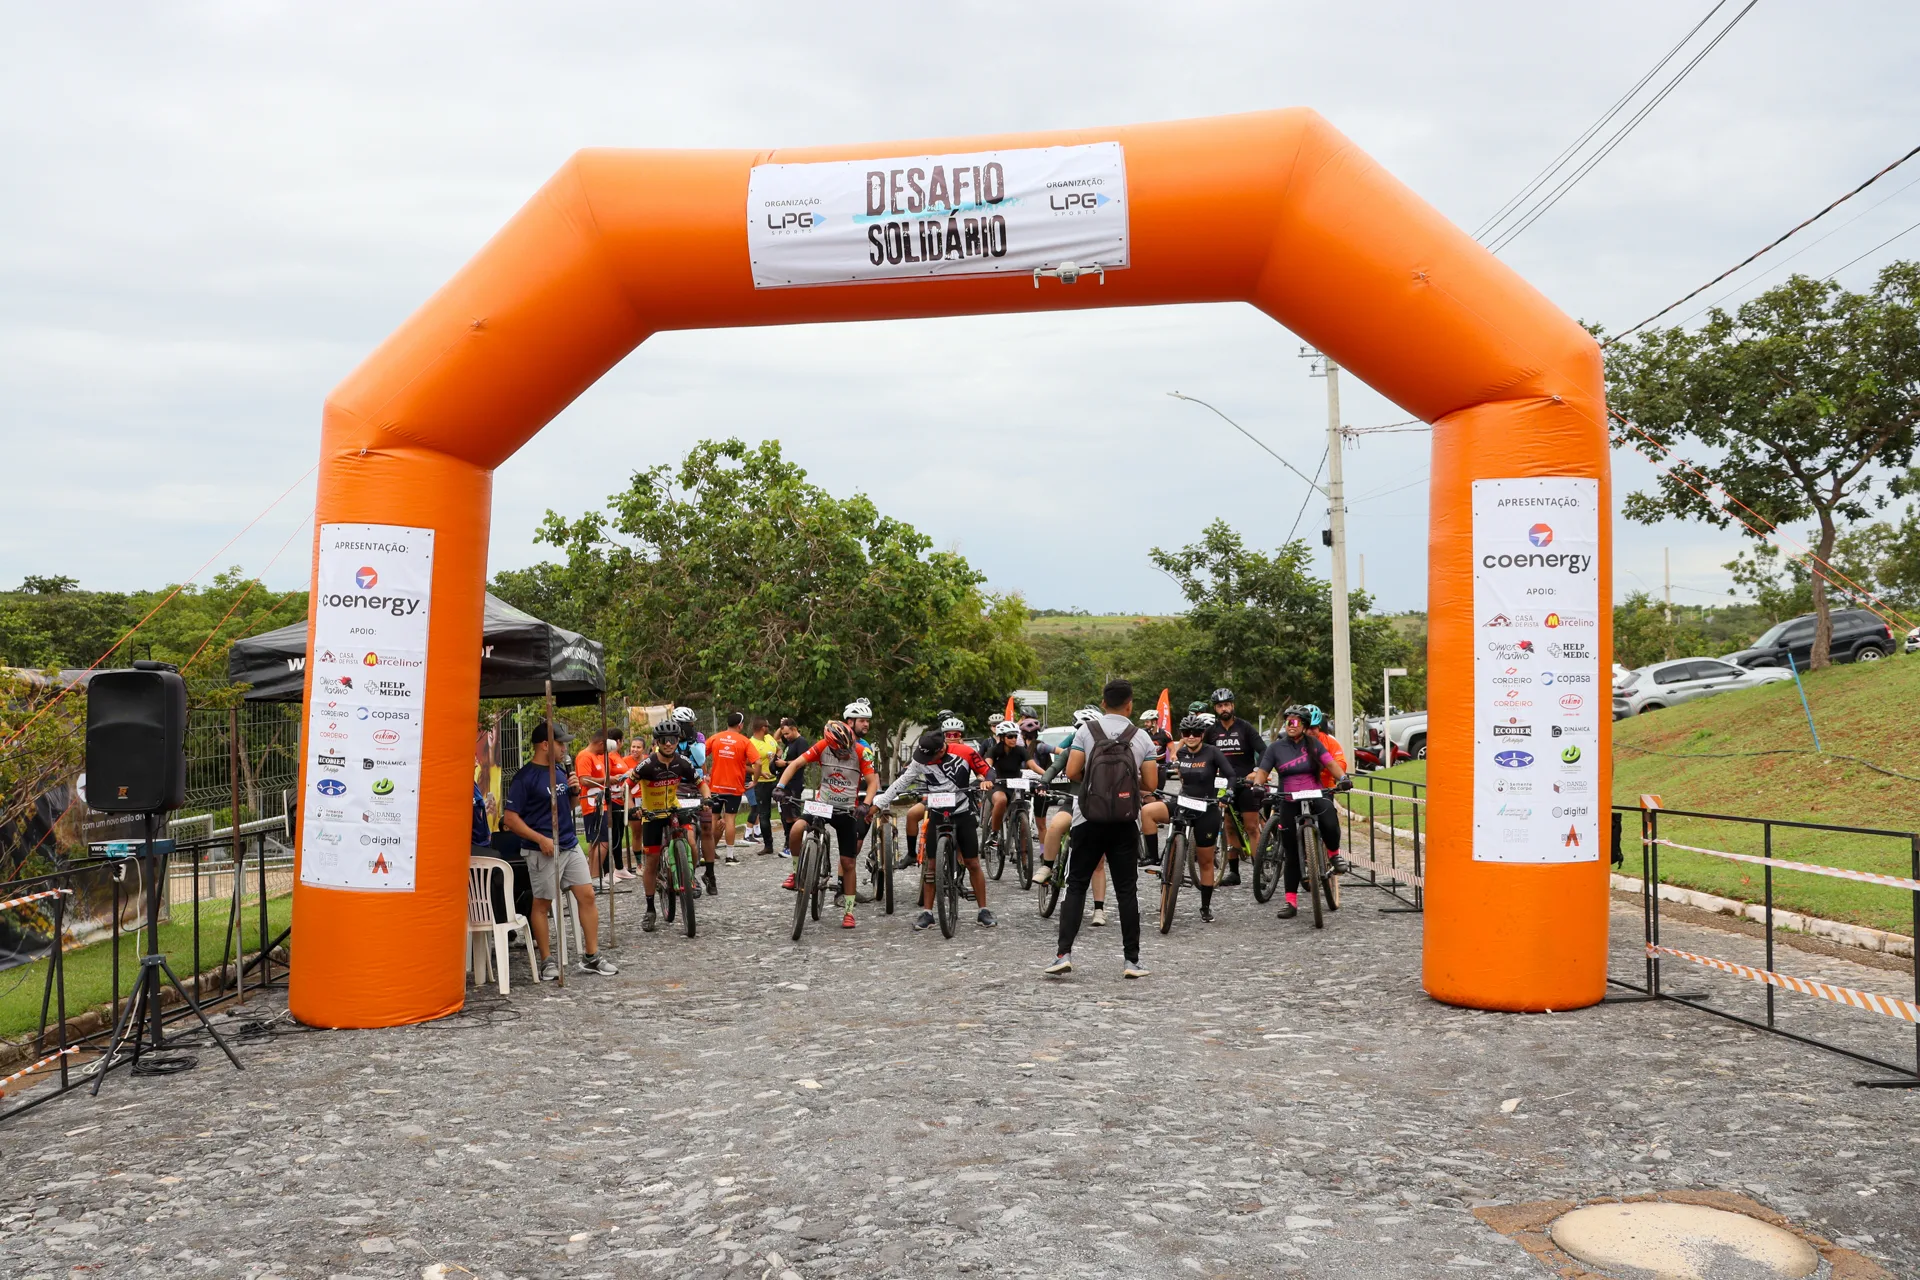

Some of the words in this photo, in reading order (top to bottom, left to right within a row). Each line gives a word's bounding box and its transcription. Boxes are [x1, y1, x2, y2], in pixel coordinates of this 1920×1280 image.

[866, 161, 1005, 217] DESAFIO
[1046, 177, 1106, 189] ORGANIZAÇÃO:
[764, 198, 822, 207] ORGANIZAÇÃO:
[1049, 192, 1098, 211] LPG
[1053, 208, 1098, 217] SPORTS
[767, 211, 814, 230] LPG
[867, 208, 1008, 267] SOLIDÁRIO
[1497, 496, 1580, 509] APRESENTAÇÃO:
[334, 541, 409, 554] APRESENTAÇÃO:
[1483, 554, 1591, 574] coenergy
[322, 594, 420, 616] coenergy
[350, 627, 377, 635] APOIO:
[380, 681, 405, 689] HELP
[1557, 673, 1591, 685] copasa
[379, 689, 411, 697] MEDIC
[321, 709, 349, 718] CORDEIRO
[371, 709, 410, 721] copasa
[319, 731, 348, 740] CORDEIRO
[1494, 727, 1531, 736] ECOBIER
[1563, 806, 1588, 817] digital
[82, 822, 95, 830] com
[96, 820, 105, 828] um
[106, 818, 119, 826] novo
[120, 814, 134, 823] estilo
[372, 836, 401, 846] digital
